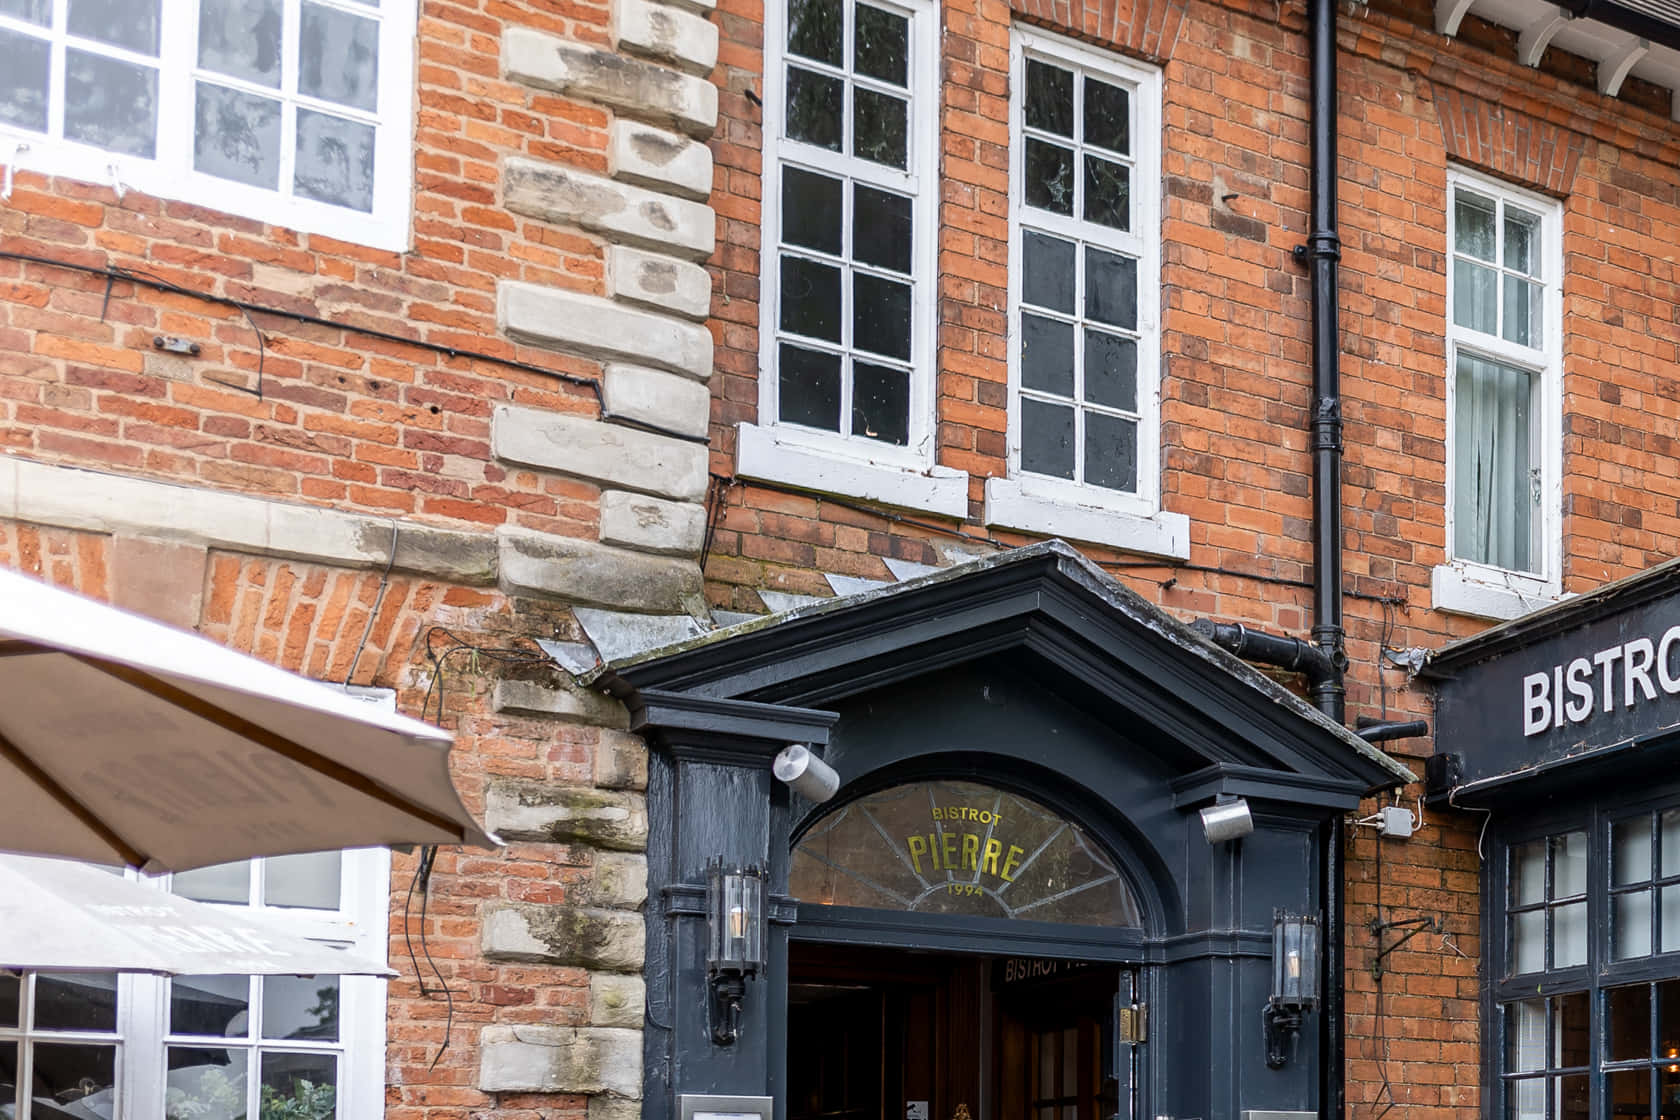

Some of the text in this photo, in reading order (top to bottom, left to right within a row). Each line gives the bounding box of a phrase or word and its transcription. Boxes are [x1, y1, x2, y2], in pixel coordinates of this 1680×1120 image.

[931, 806, 1002, 827] BISTROT
[906, 832, 1024, 883] PIERRE
[947, 883, 984, 898] 1994
